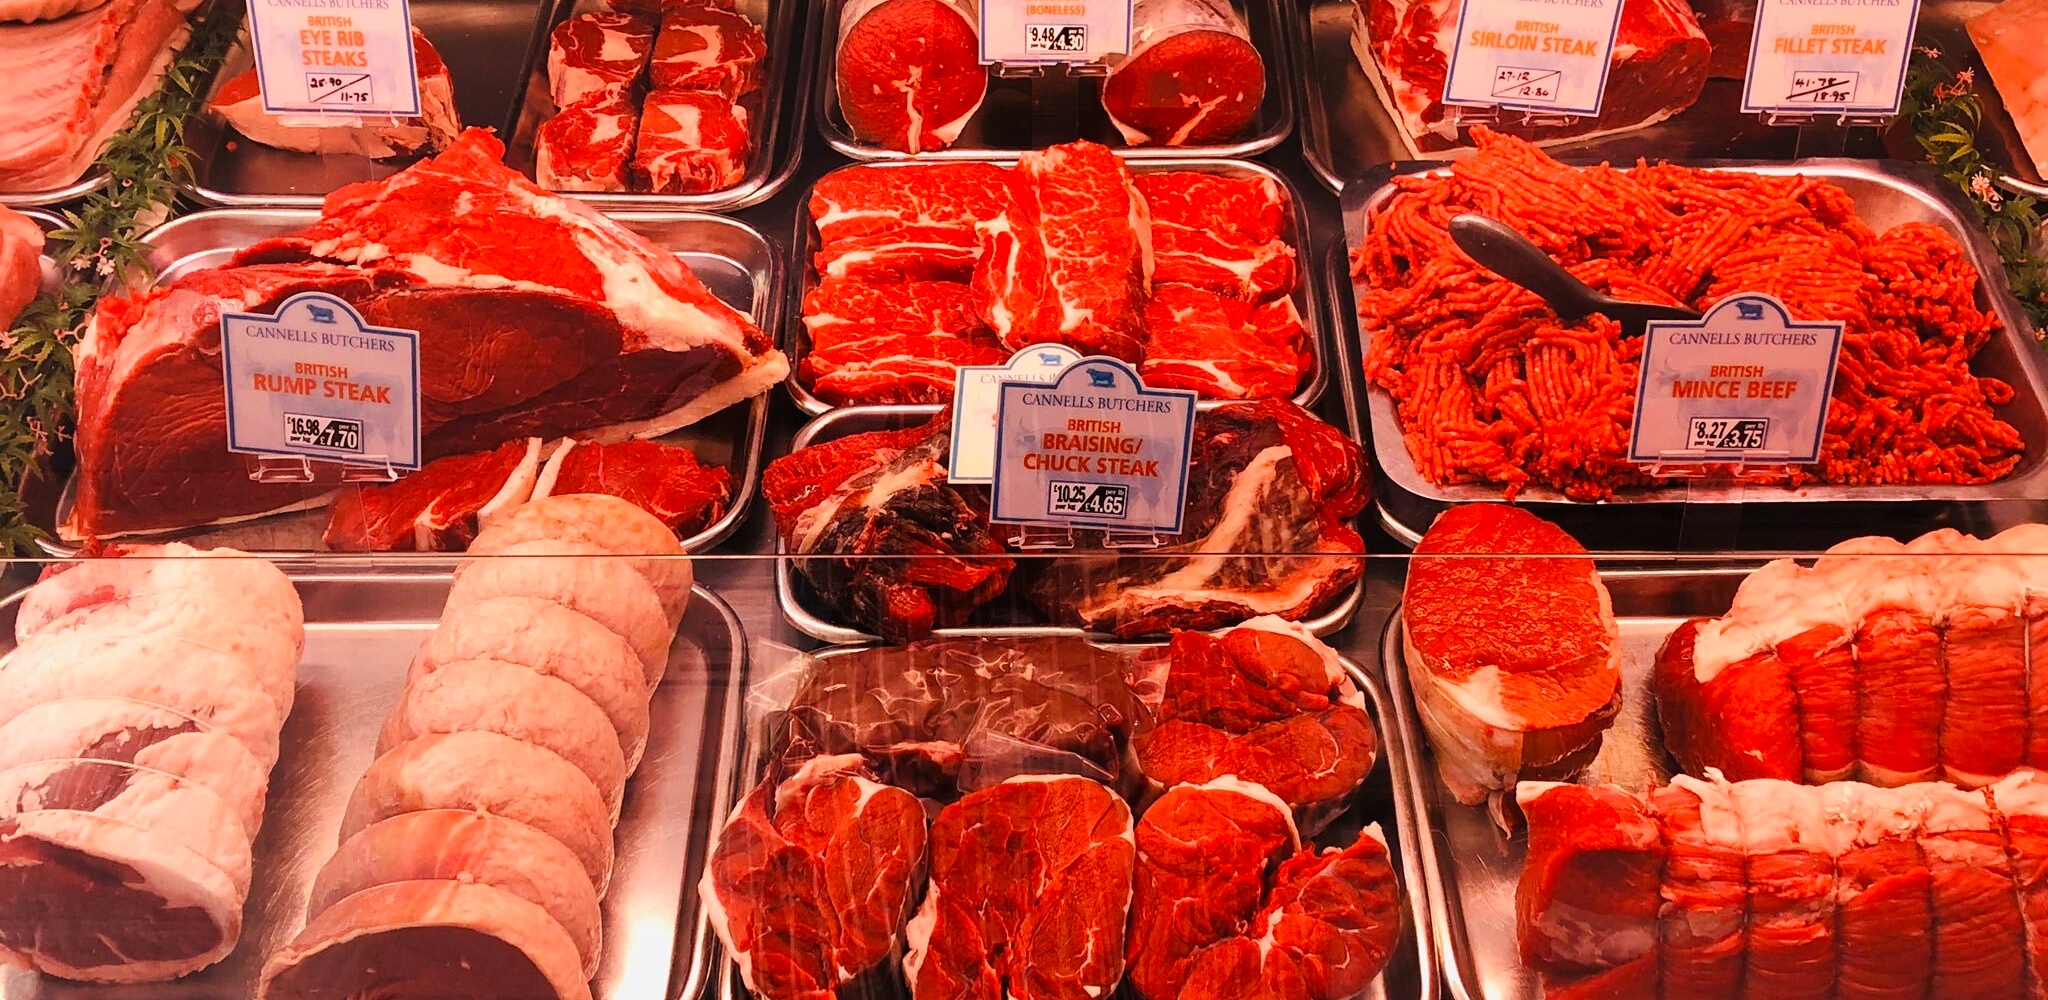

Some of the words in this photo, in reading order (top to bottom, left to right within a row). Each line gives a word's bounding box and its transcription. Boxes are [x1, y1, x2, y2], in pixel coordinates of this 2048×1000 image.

[1026, 5, 1086, 17] (BONELESS)
[308, 16, 352, 27] BRITISH
[1515, 20, 1560, 33] BRITISH
[1811, 24, 1856, 35] BRITISH
[300, 30, 332, 46] EYE
[337, 31, 365, 46] RIB
[1053, 35, 1083, 50] £4.30
[1470, 31, 1539, 51] SIRLOIN
[1542, 37, 1598, 57] STEAK
[1774, 38, 1830, 54] FILLET
[1831, 39, 1888, 54] STEAK
[303, 50, 368, 67] STEAKS
[245, 325, 318, 343] CANNELLS
[322, 334, 395, 352] BUTCHERS
[1669, 332, 1740, 345] CANNELLS
[1744, 333, 1818, 346] BUTCHERS
[295, 362, 348, 379] BRITISH
[1710, 365, 1764, 378] BRITISH
[254, 373, 317, 396] RUMP
[323, 380, 391, 404] STEAK
[1672, 380, 1741, 399] MINCE
[1746, 381, 1798, 399] BEEF
[1022, 393, 1094, 409] CANNELLS
[1098, 398, 1172, 413] BUTCHERS
[287, 417, 320, 436] £16.98
[1067, 419, 1121, 434] BRITISH
[1695, 421, 1728, 439] £8.27
[320, 429, 357, 449] £7.70
[1043, 433, 1144, 455] BRAISING/
[1723, 430, 1762, 448] £3.75
[1023, 453, 1091, 473] CHUCK
[1096, 457, 1160, 478] STEAK
[1053, 484, 1086, 503] £10.25
[1068, 503, 1076, 511] kg
[1085, 495, 1123, 514] £4.65
